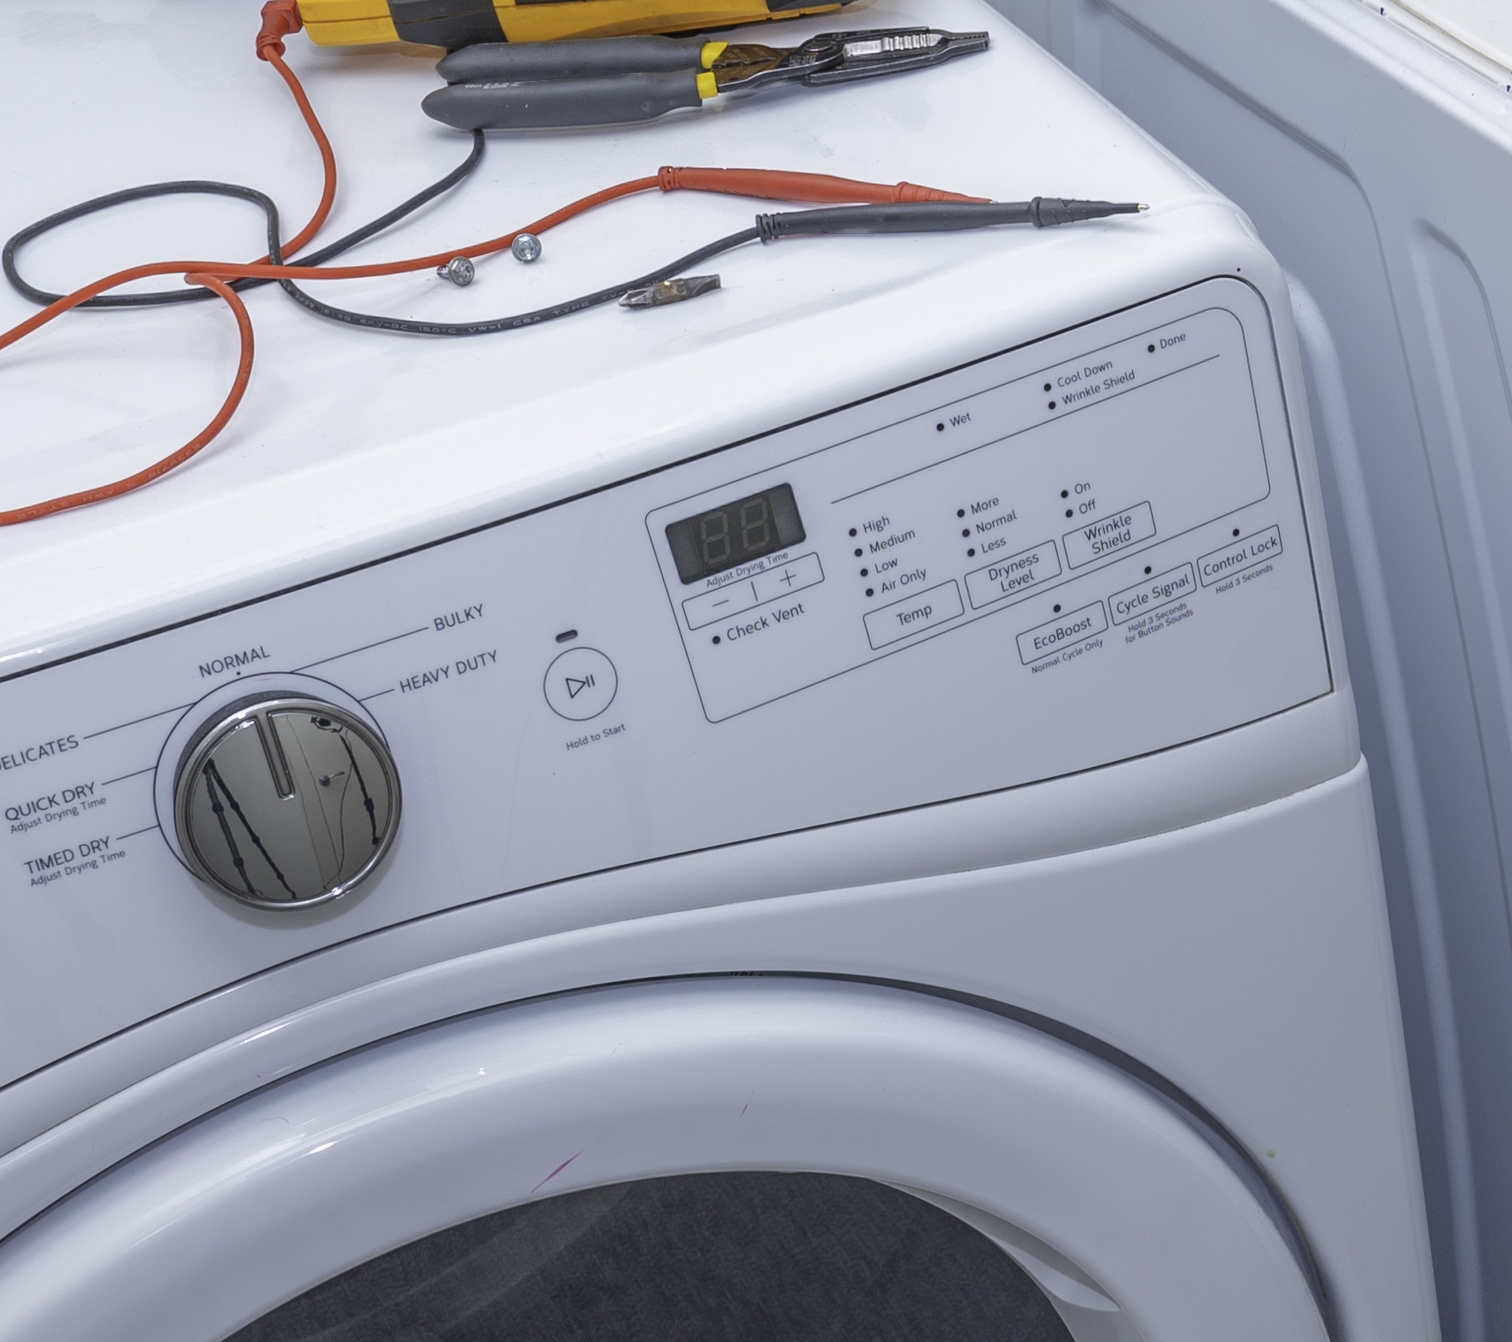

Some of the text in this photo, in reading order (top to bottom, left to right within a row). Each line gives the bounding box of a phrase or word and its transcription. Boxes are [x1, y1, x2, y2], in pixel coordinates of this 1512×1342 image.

[512, 314, 543, 328] CSA
[552, 299, 591, 318] TYPE
[1159, 332, 1187, 350] Done
[1057, 359, 1114, 388] Cool Down
[1061, 369, 1136, 406] Wrinkle Shield
[949, 411, 973, 428] Wet
[1073, 480, 1091, 495] On
[970, 495, 1000, 516] More
[1078, 498, 1098, 516] Off
[862, 515, 891, 536] High
[975, 509, 1018, 535] Normal
[1084, 513, 1133, 543] Wrinkle
[868, 527, 917, 555] Medium
[981, 536, 1008, 554] Less
[1091, 529, 1133, 556] Shield
[706, 551, 789, 589] Adjust Drying Time
[874, 557, 899, 575] Low
[987, 551, 1041, 583] Dryness
[1202, 536, 1279, 578] Control Lock
[880, 567, 928, 595] Air Only
[1000, 568, 1036, 594] Level
[1215, 563, 1275, 595] Hold 3 Seconds
[1116, 572, 1191, 617] Cycle Signal
[432, 602, 484, 633] BULKY
[726, 602, 806, 642] Check Vent
[895, 603, 934, 628] Temp
[1124, 608, 1195, 645] for Button Sounds
[1127, 600, 1188, 634] Hold 3 Seconds
[1032, 615, 1093, 651] EcoBoost
[198, 644, 272, 679] NORMAL
[398, 649, 498, 695] HEAVY DUTY
[1031, 638, 1105, 676] Normal Cycle Only
[565, 722, 627, 752] Hold to Start
[4, 781, 95, 821] QUICK DRY
[10, 796, 107, 834] Adjust Drying Time
[23, 835, 110, 875] TIMED DRY
[30, 849, 126, 888] Adjust Drying Time
